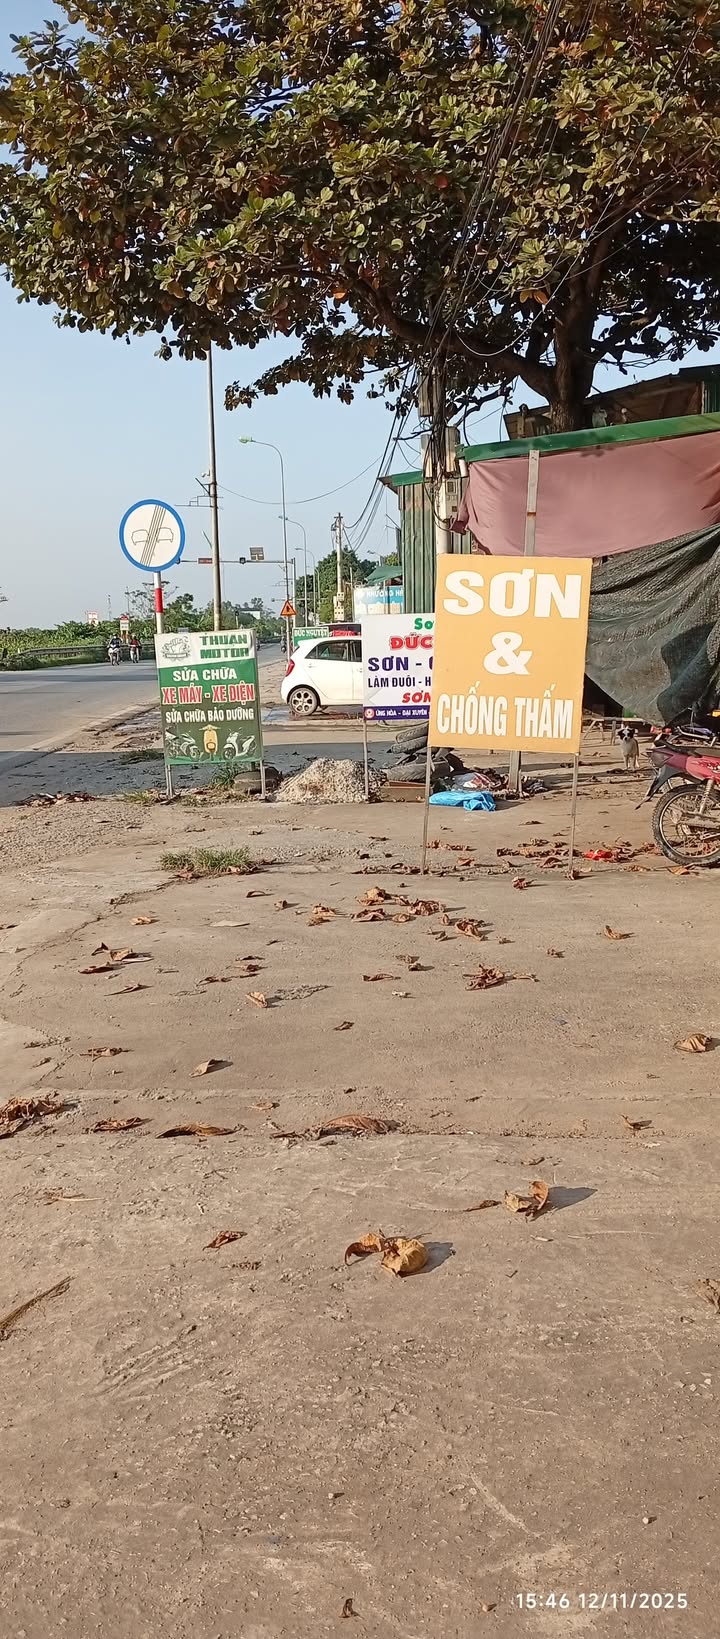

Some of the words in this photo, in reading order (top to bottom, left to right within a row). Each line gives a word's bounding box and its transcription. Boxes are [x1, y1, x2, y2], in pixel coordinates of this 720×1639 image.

[443, 568, 582, 619] SƠN
[390, 632, 433, 649] ĐỨC
[200, 647, 249, 659] MOTOR
[483, 631, 534, 675] &
[368, 656, 409, 672] SƠN
[172, 667, 199, 682] SỬA
[202, 666, 238, 681] CHỮA
[161, 686, 178, 705] XE
[178, 682, 203, 704] MÁY
[211, 684, 227, 703] XE
[228, 681, 255, 706] ĐIỆN
[165, 708, 182, 723] SỬA
[184, 708, 206, 723] CHỮA
[207, 706, 224, 722] BẢO
[226, 706, 255, 721] DƯỠNG
[437, 681, 508, 736] CHỐNG
[514, 683, 574, 739] THẤM
